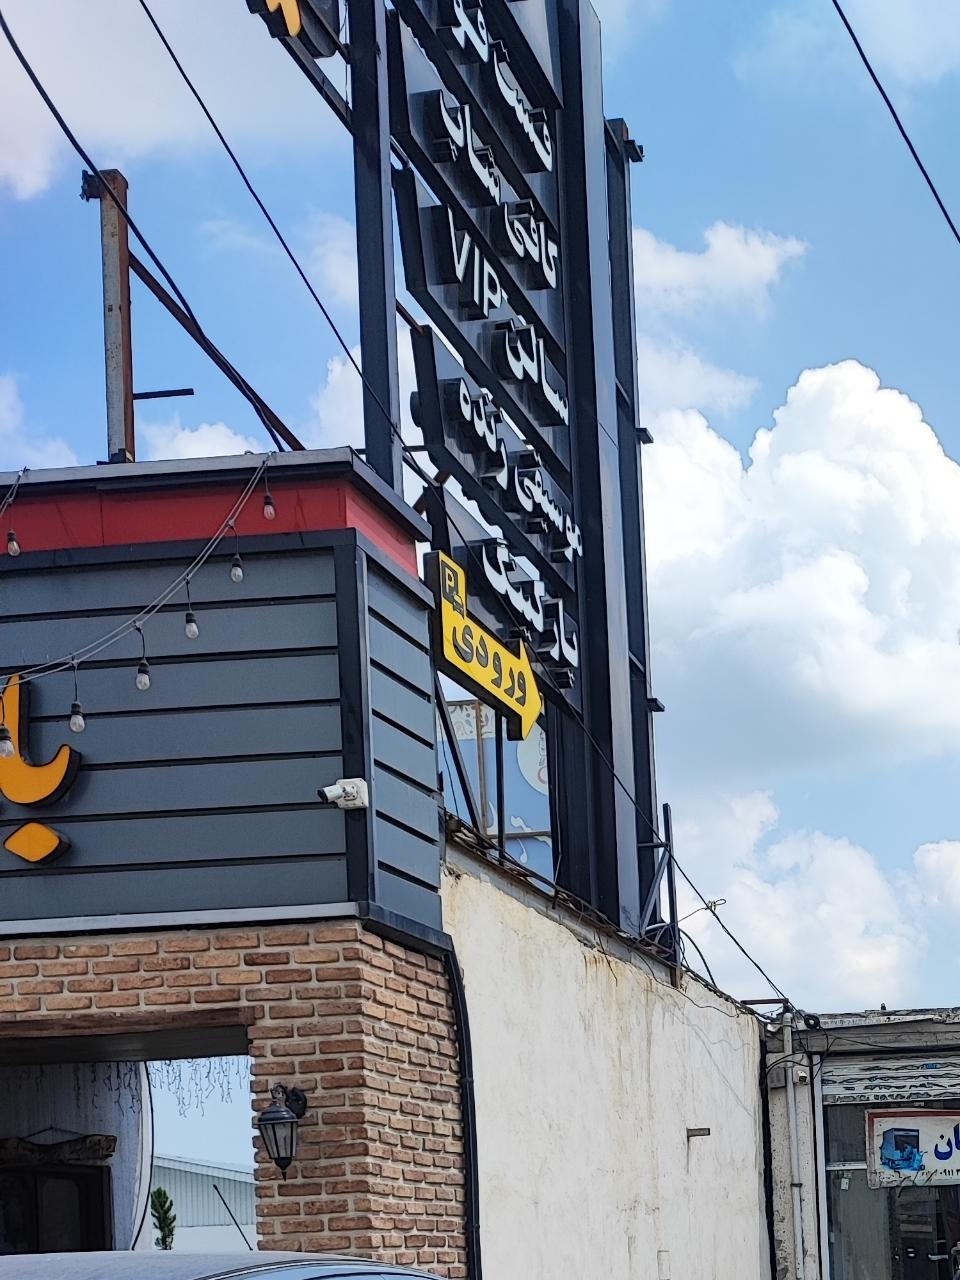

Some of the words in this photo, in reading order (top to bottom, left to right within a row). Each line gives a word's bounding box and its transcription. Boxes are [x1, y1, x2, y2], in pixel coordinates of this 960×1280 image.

[440, 89, 501, 207] شاپ
[494, 40, 553, 172] فست
[448, 203, 501, 318] VIP
[504, 200, 559, 289] کافی
[505, 319, 569, 426] سالن
[460, 377, 508, 490] زنده
[515, 451, 583, 562] موسیقی
[452, 624, 528, 708] ورودی
[482, 538, 578, 688] پارکینگ
